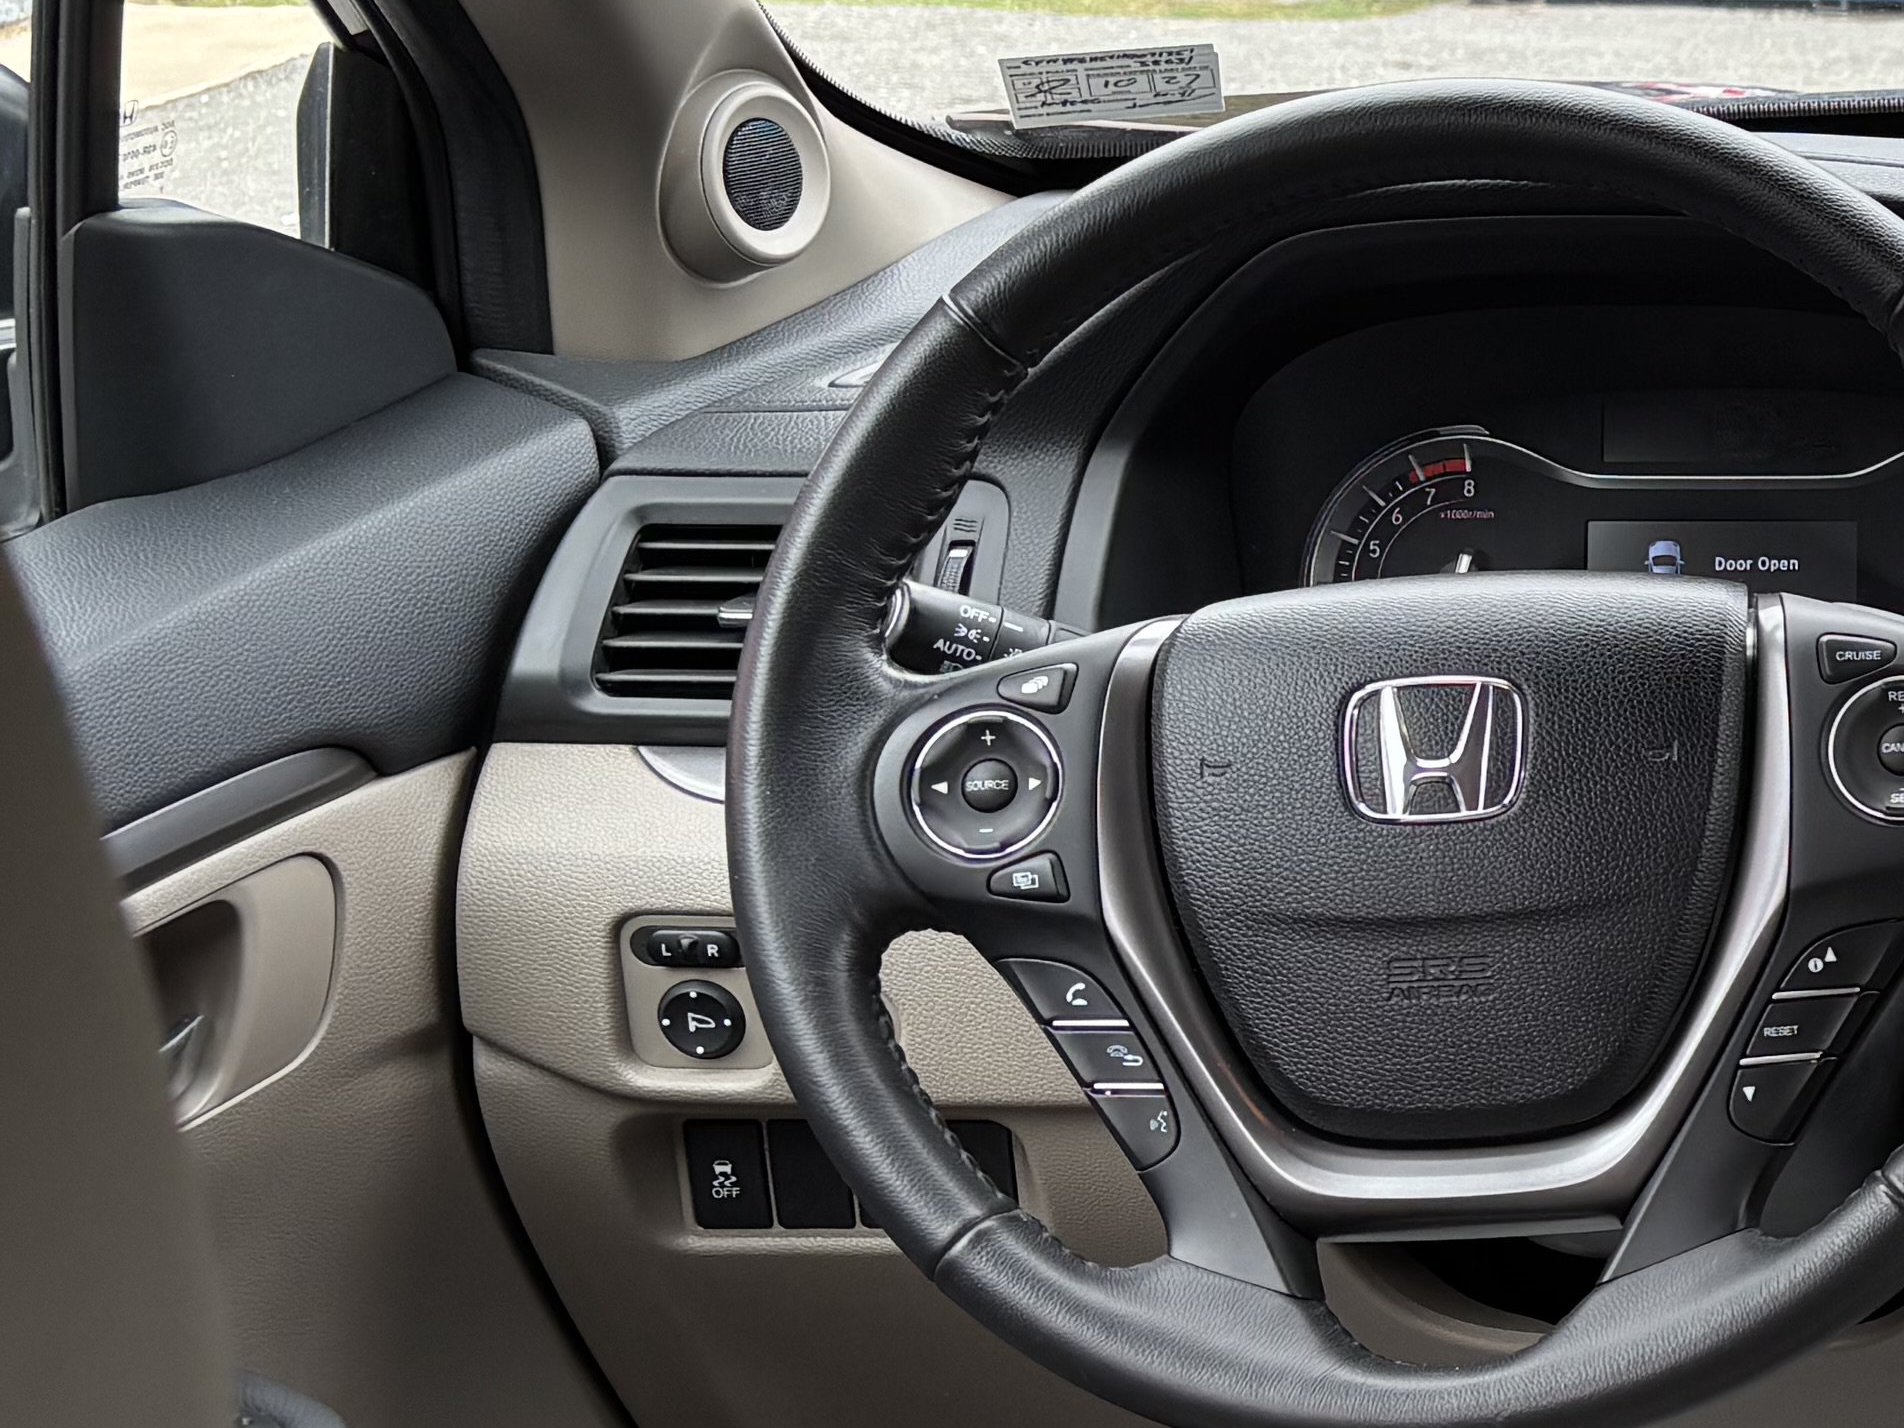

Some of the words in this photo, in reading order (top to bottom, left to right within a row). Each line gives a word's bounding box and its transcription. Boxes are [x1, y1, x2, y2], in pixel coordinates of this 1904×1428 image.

[1424, 488, 1437, 506] 7
[1463, 479, 1475, 498] 8
[1391, 507, 1403, 525] 6
[1368, 540, 1381, 558] 5
[1715, 556, 1753, 571] Door
[1757, 556, 1799, 573] Open
[960, 605, 990, 622] OFF
[933, 638, 977, 661] AUTO
[1835, 650, 1882, 662] CRUISE
[965, 779, 1010, 793] SOURCE
[661, 943, 672, 957] L
[706, 943, 719, 958] R
[1387, 955, 1494, 982] SRS
[1763, 1024, 1800, 1038] RESET
[711, 1187, 741, 1199] OFF
